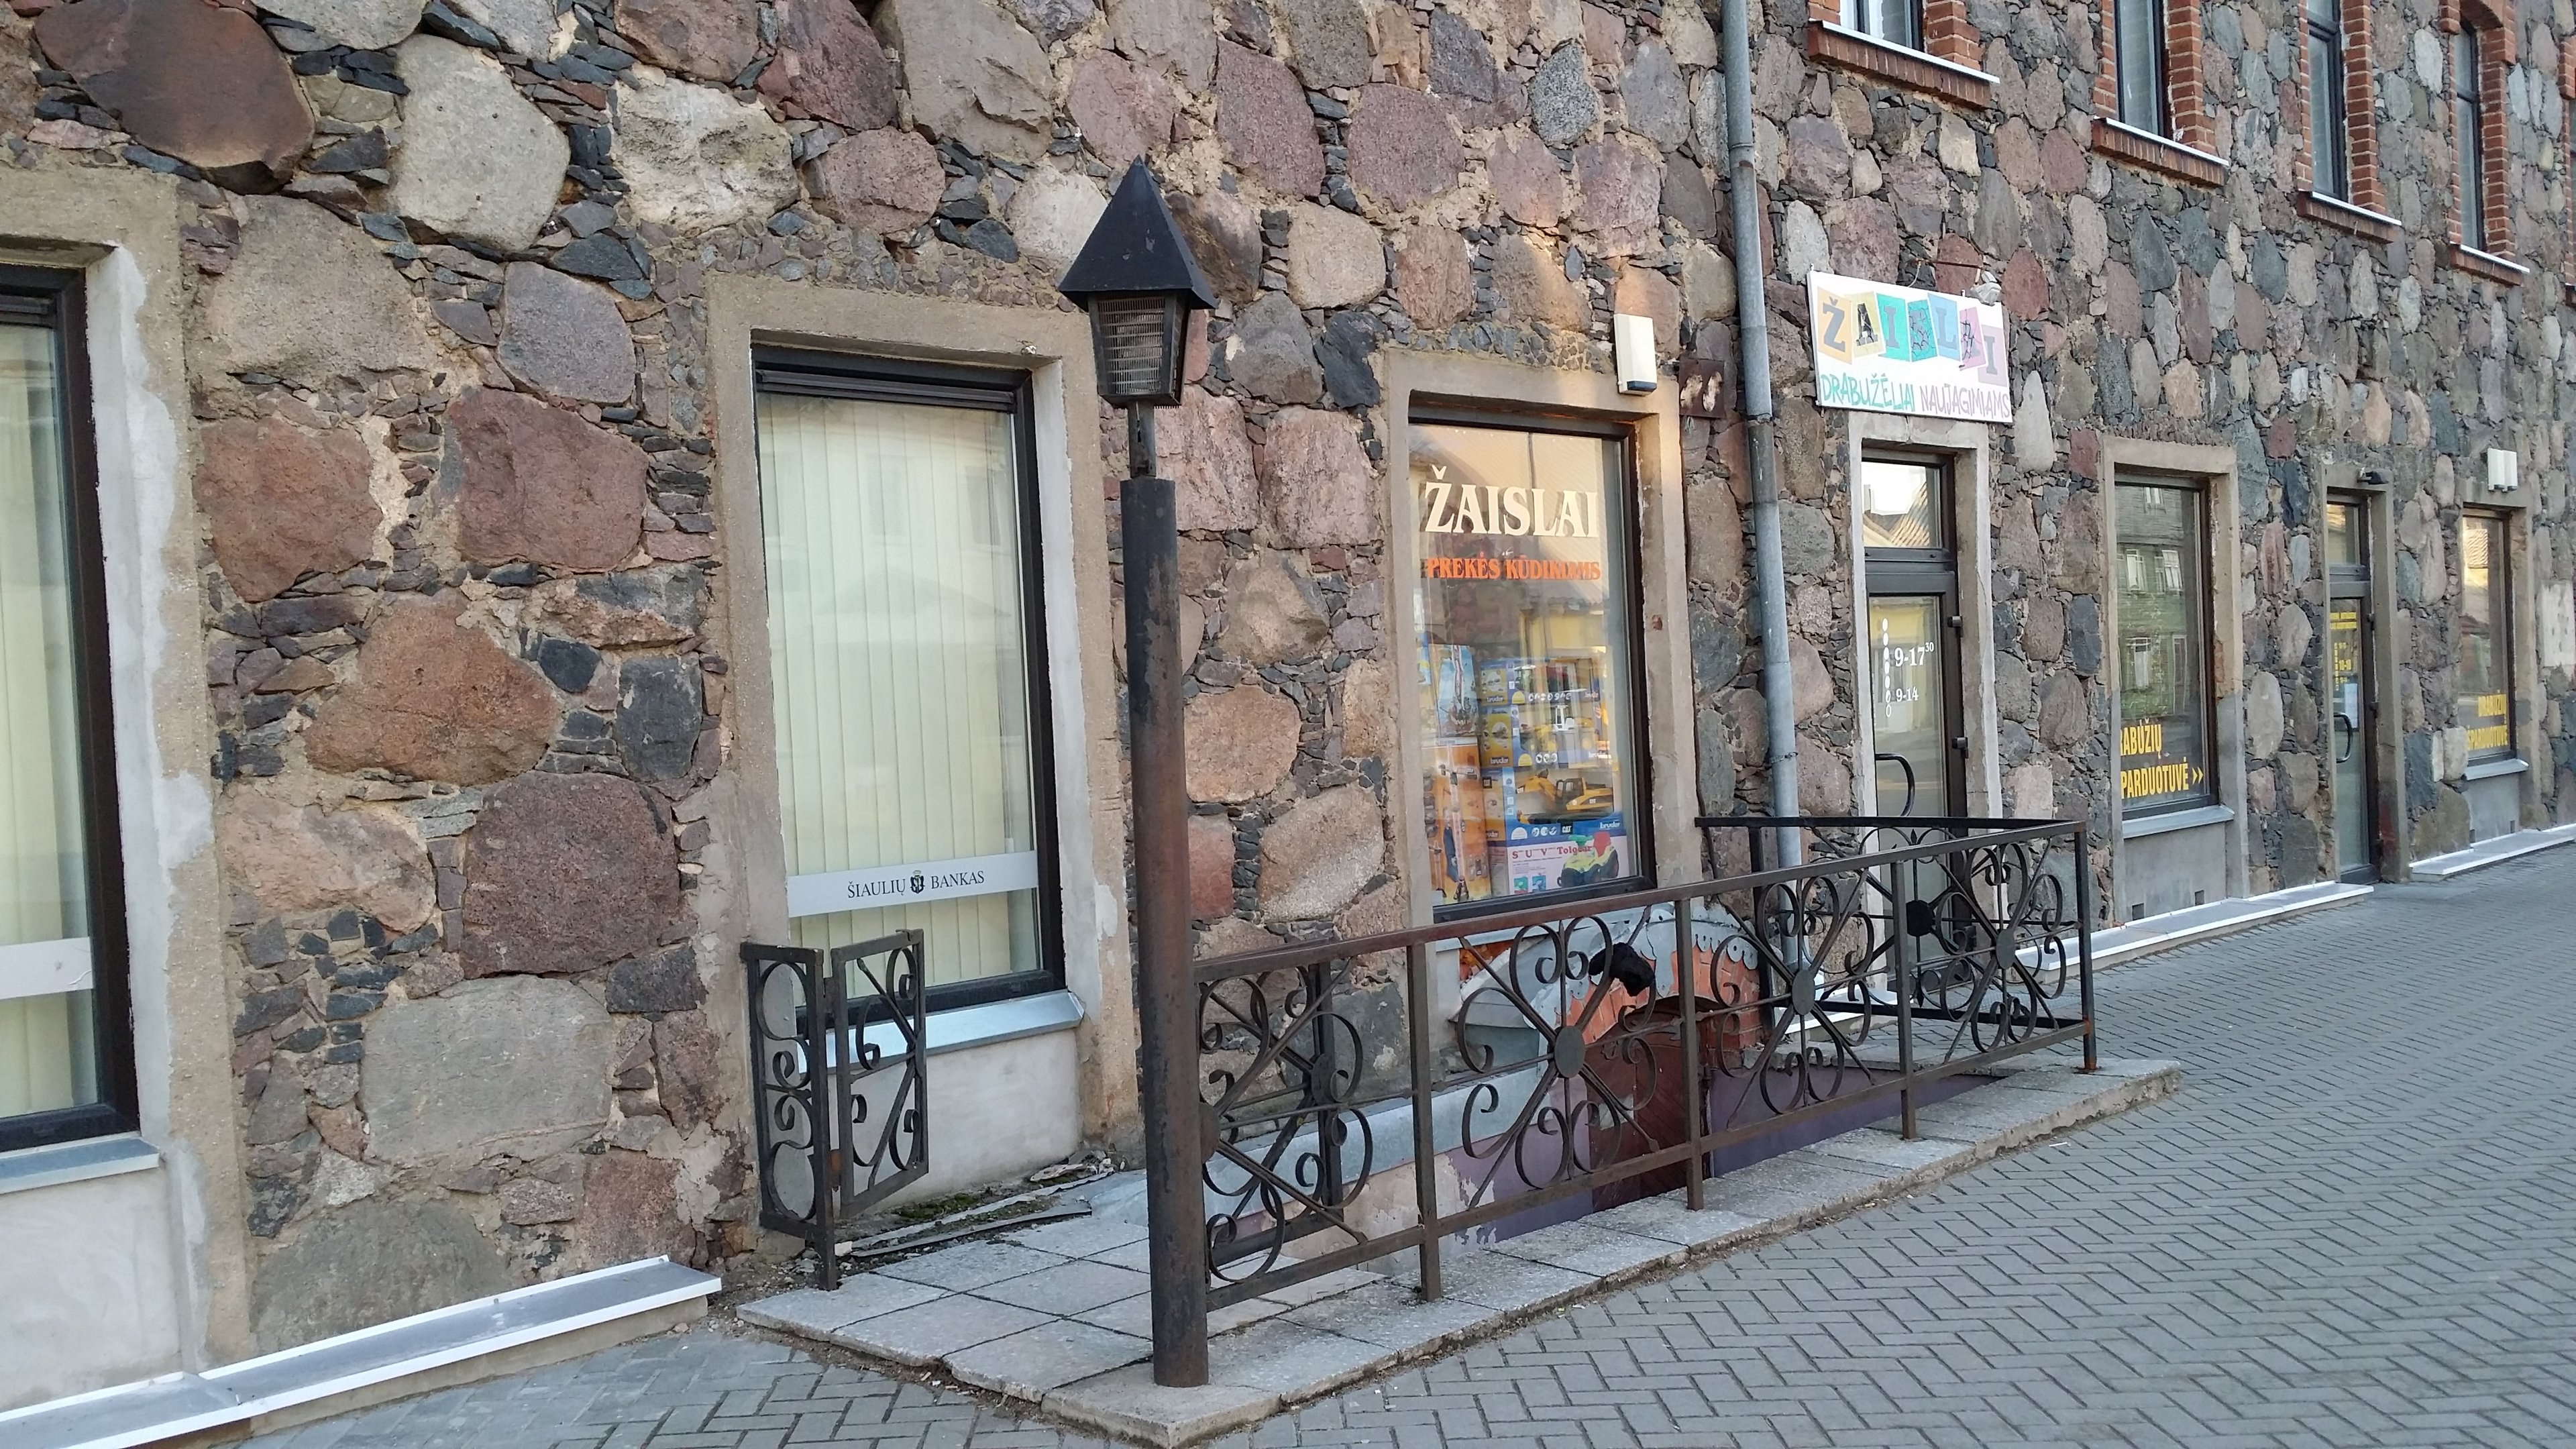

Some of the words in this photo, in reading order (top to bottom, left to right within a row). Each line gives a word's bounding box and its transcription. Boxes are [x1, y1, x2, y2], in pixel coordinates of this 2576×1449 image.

[1823, 296, 1999, 376] ŽAISLAI
[1920, 383, 2010, 419] NAUJAGIMIAMS
[1424, 464, 1599, 538] ŽAISLAI
[1427, 551, 1501, 579] PREKĖS
[1505, 554, 1601, 580] KŪDIKIAMS
[1896, 686, 1919, 702] 9-14
[2121, 756, 2190, 800] PARDUOTUVĖ
[1562, 825, 1572, 833] CAT
[1599, 821, 1621, 829] bruder
[847, 877, 906, 899] ŠIAULIŲ
[930, 871, 985, 890] BANKAS
